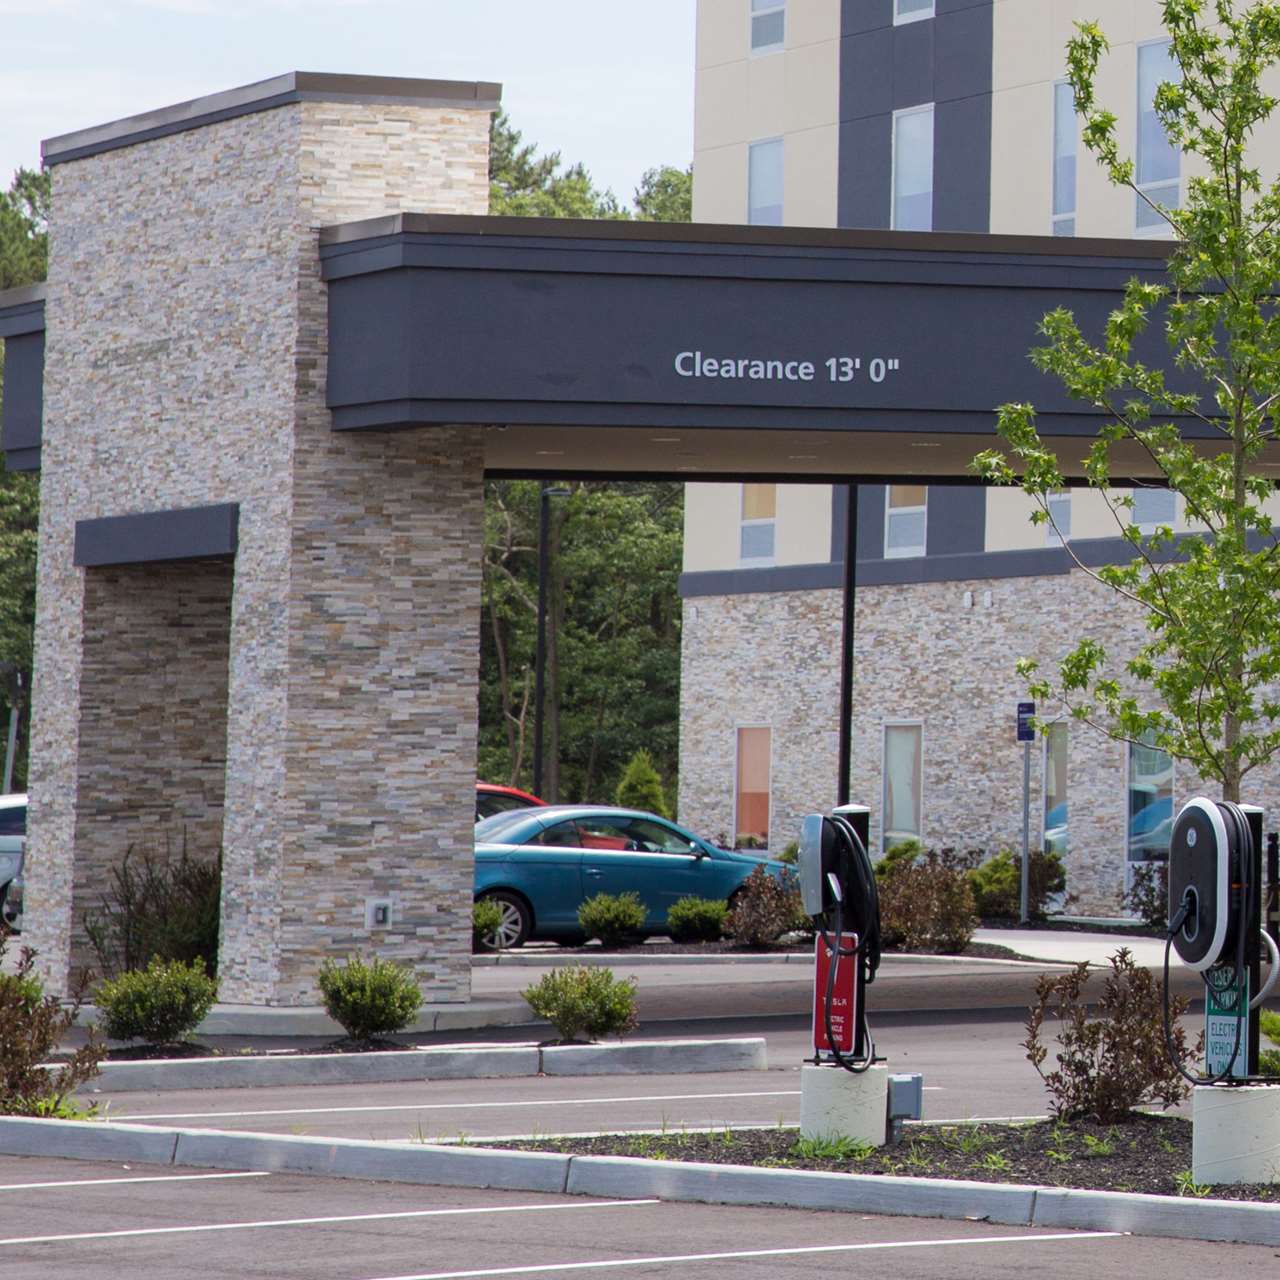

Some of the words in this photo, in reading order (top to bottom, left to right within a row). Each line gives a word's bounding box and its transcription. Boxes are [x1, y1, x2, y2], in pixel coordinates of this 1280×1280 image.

[674, 351, 815, 381] Clearance
[824, 357, 861, 382] 13'
[869, 358, 900, 383] 0"
[822, 996, 847, 1006] TSLA
[1211, 1022, 1237, 1037] ELECTR
